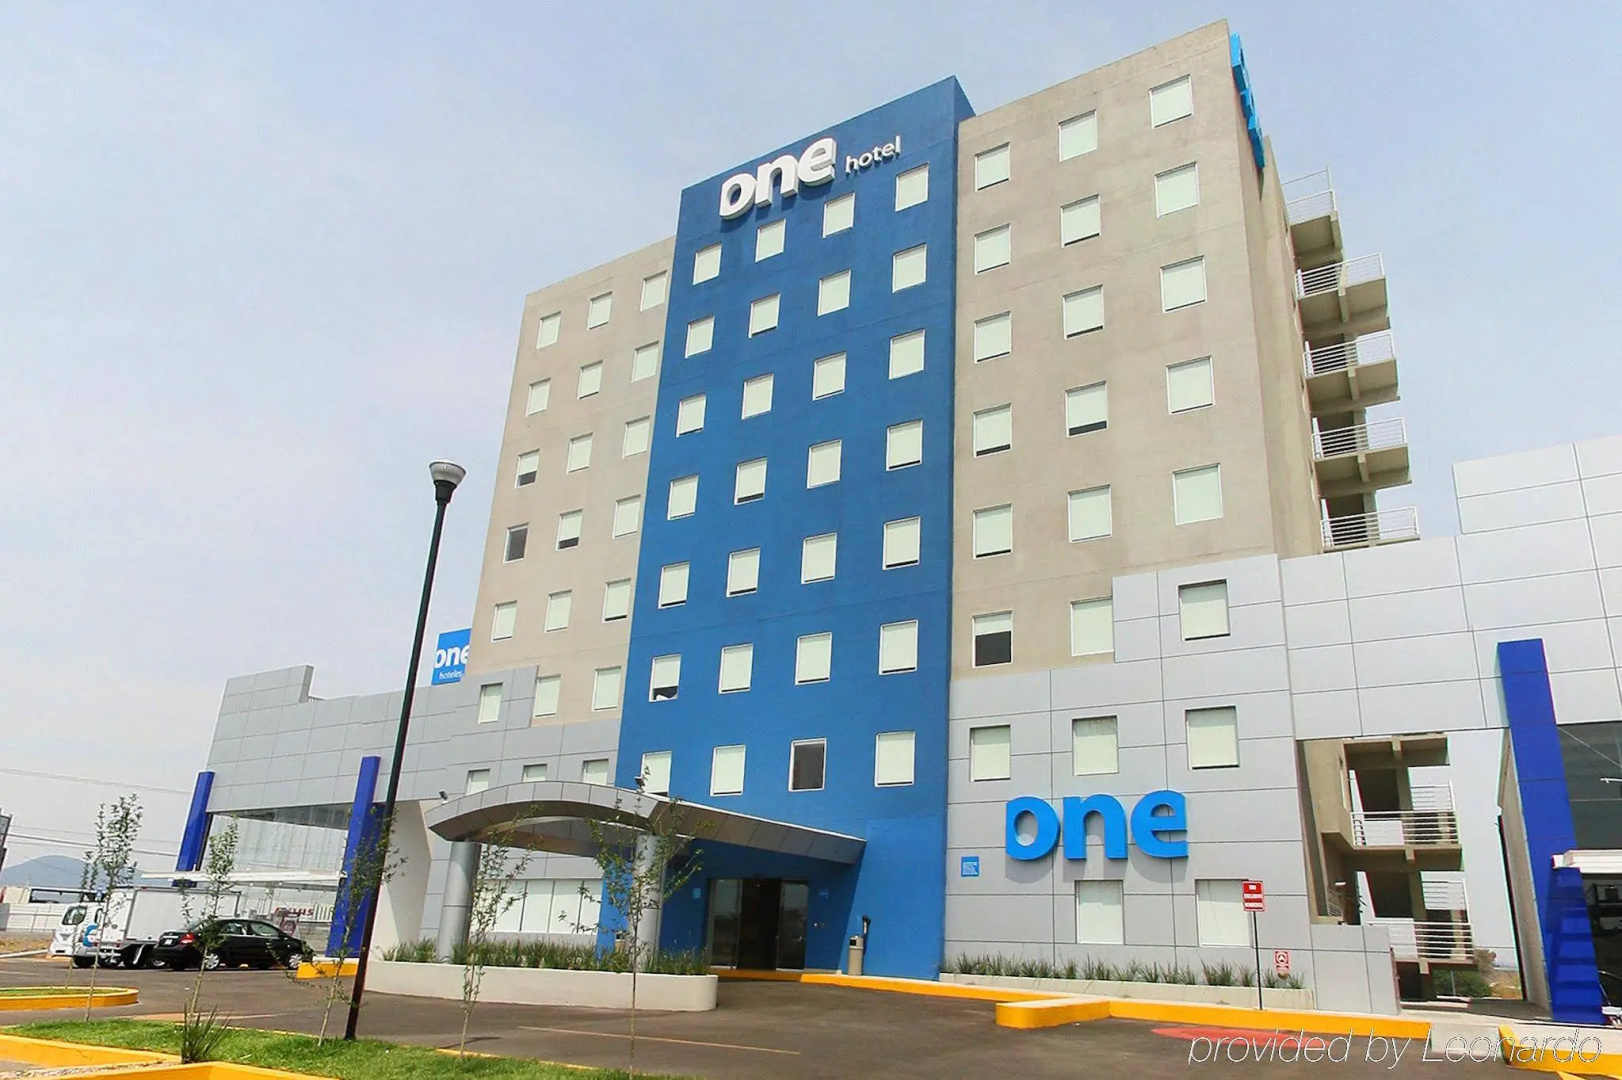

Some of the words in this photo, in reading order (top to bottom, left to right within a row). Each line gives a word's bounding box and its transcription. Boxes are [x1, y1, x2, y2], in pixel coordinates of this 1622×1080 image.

[719, 138, 837, 219] one
[845, 135, 901, 174] hotel
[1005, 790, 1189, 861] one
